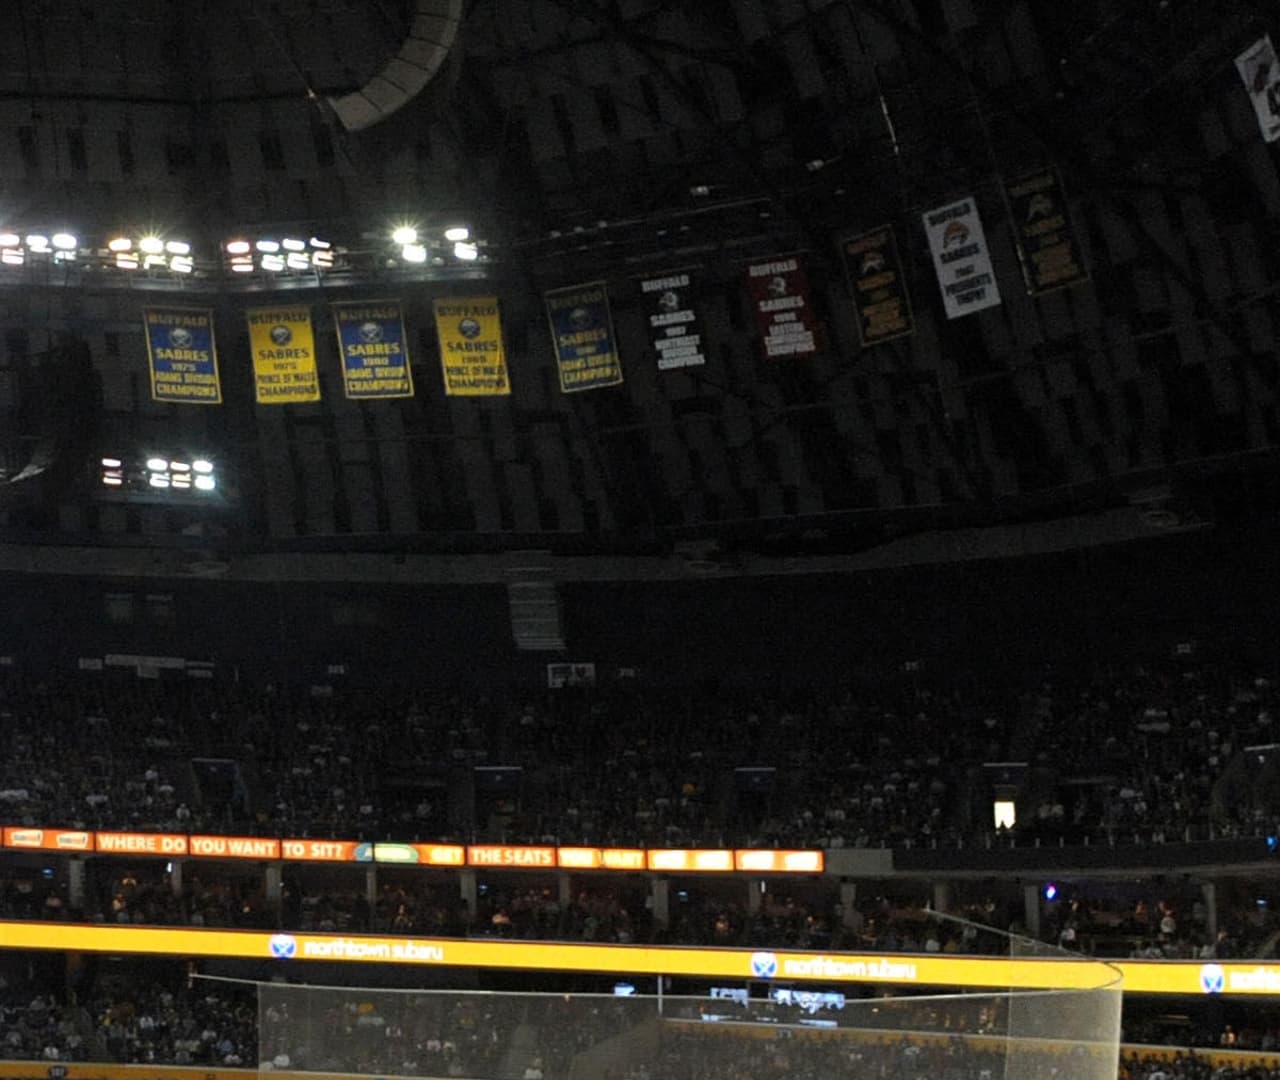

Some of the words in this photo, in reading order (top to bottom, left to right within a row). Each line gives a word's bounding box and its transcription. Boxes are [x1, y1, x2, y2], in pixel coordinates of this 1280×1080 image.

[258, 348, 310, 360] SABRES
[347, 342, 401, 356] SABRES
[446, 341, 498, 353] SABRES
[155, 348, 209, 362] SABRES
[259, 384, 317, 396] CHAMPIONS
[99, 835, 156, 851] WHERE
[161, 837, 186, 852] DO
[191, 839, 225, 855] YOU
[227, 840, 276, 857] WANT
[282, 842, 305, 858] TO
[311, 843, 343, 859] SIT?
[430, 845, 463, 862] GET
[472, 847, 502, 863] THE
[505, 848, 551, 864] SEATS
[558, 849, 594, 866] YOU
[304, 938, 390, 959] northtown
[391, 941, 443, 961] subaru
